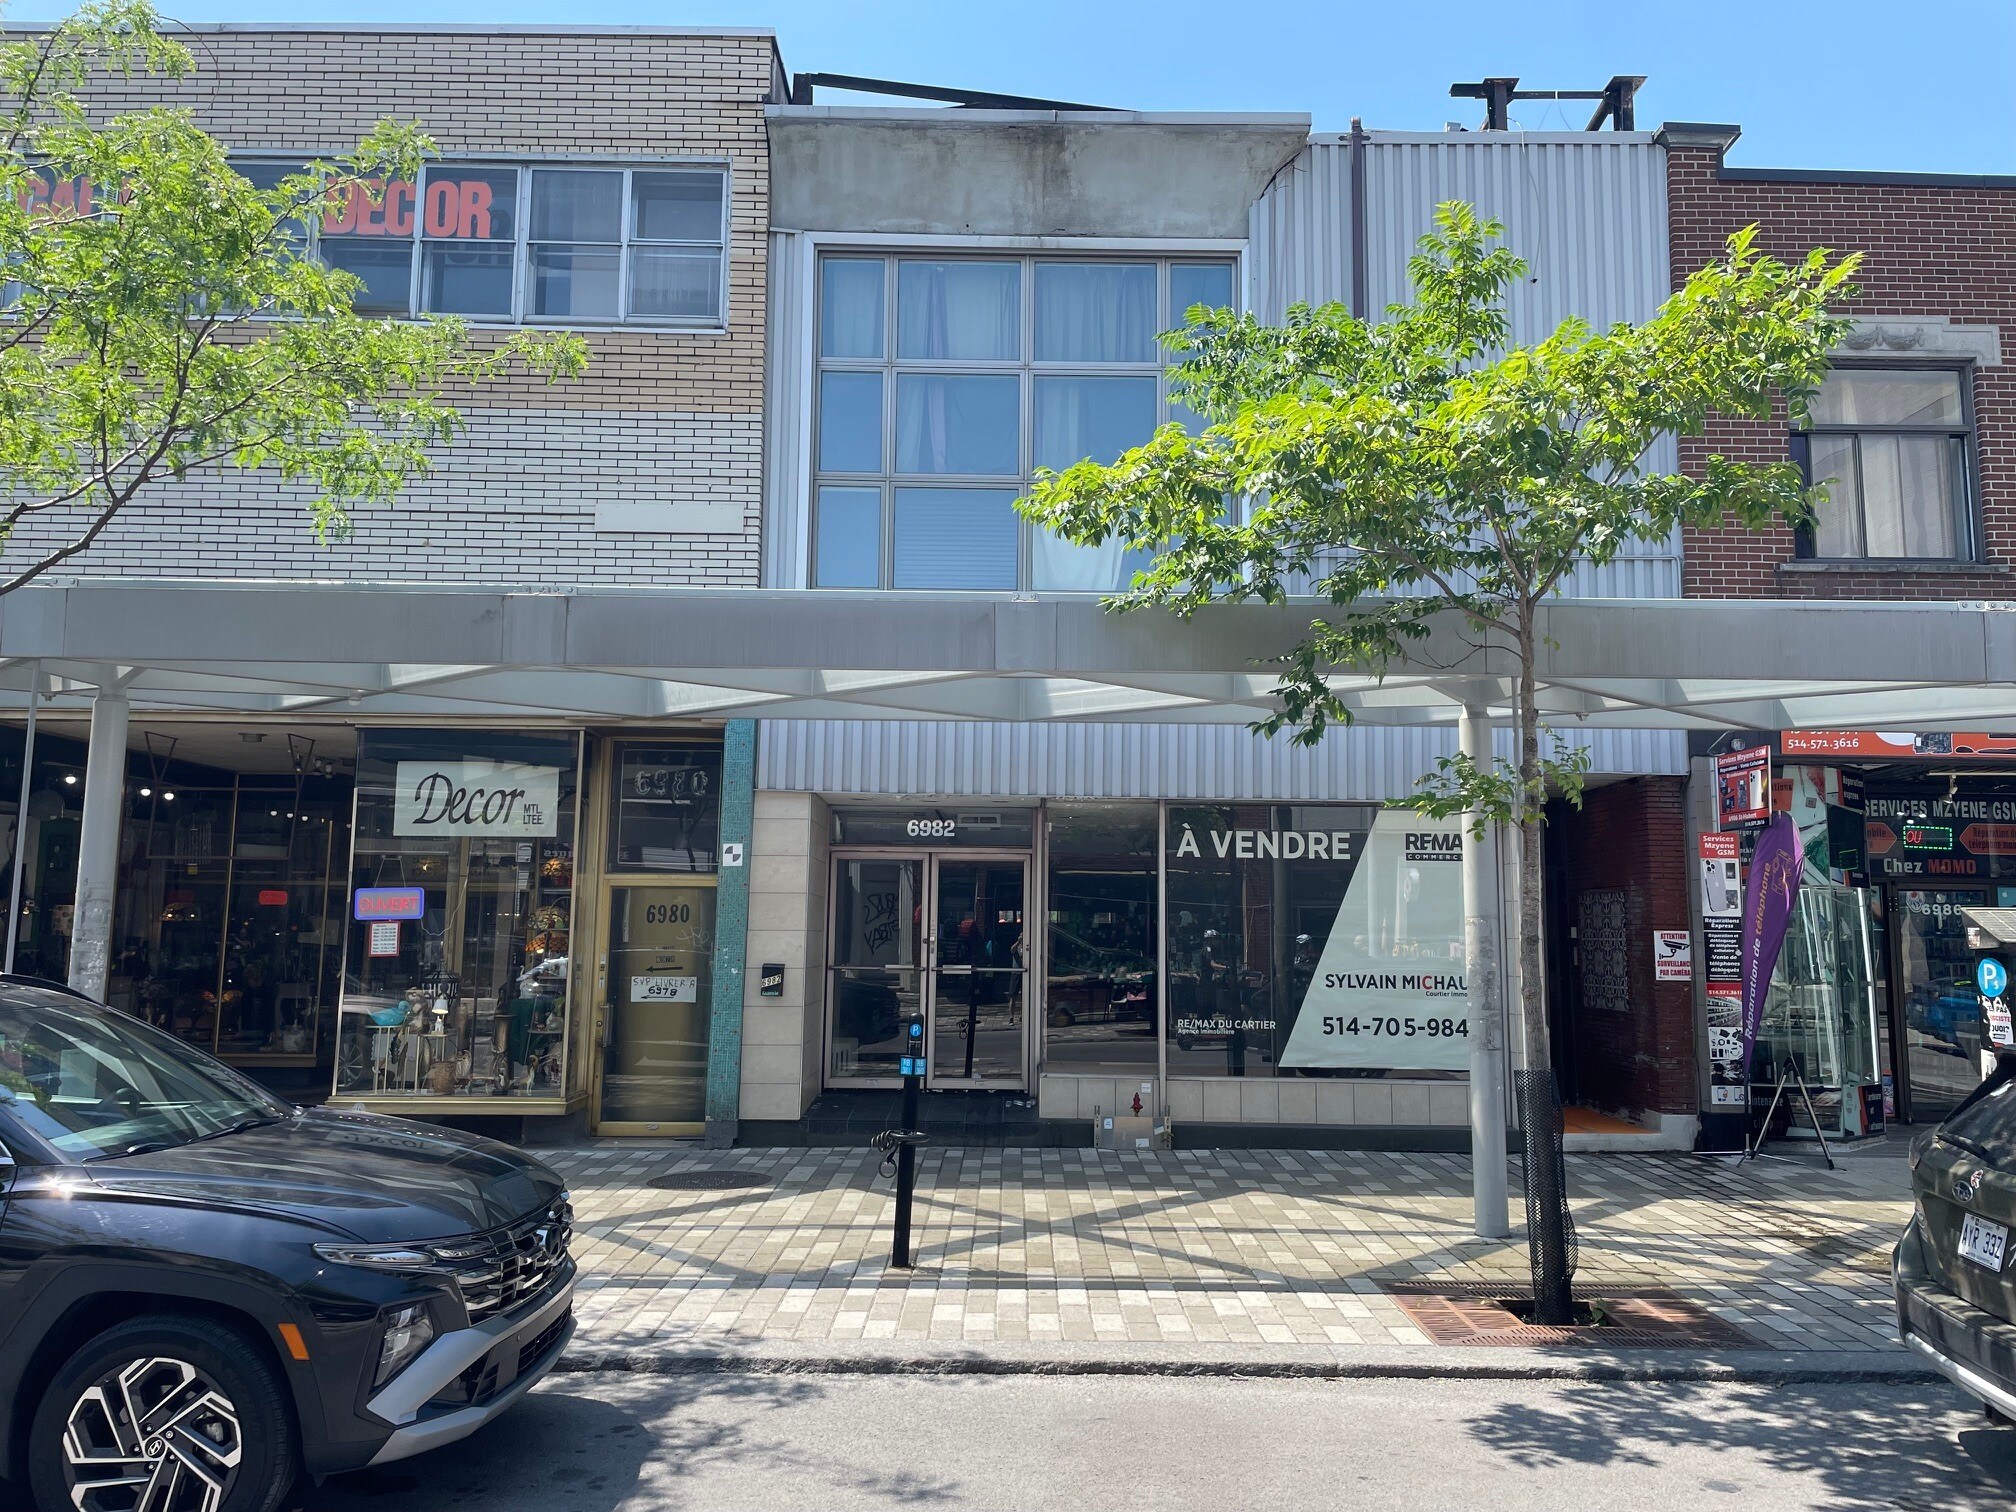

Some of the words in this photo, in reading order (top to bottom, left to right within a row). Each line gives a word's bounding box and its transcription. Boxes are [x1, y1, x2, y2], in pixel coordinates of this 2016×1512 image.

[324, 177, 494, 239] DECOR
[1788, 738, 1859, 749] 514.571.3616
[635, 770, 708, 796] 6980
[413, 772, 526, 824] Decor
[523, 804, 543, 814] MTL.
[1865, 800, 1927, 816] SERVICES
[1933, 801, 1987, 818] MZYENE
[907, 819, 955, 837] 6982
[1176, 823, 1201, 858] À
[1210, 830, 1351, 860] VENDRE
[1906, 831, 1922, 843] OU
[1704, 842, 1735, 850] Mzyene
[1883, 858, 1923, 873] Chez
[1928, 859, 1977, 874] MOMO
[360, 897, 419, 912] OUVERT
[1755, 862, 1771, 936] téléphone
[646, 904, 690, 923] 6980
[1921, 904, 1961, 916] 6986
[1755, 938, 1762, 957] de
[1657, 960, 1692, 968] SURVEILLANC
[1670, 968, 1691, 977] CAMÉRA
[633, 977, 651, 986] SVP
[655, 978, 686, 988] LIVRER
[1325, 973, 1397, 989] SYLVAIN
[1744, 958, 1762, 1039] Réparation
[1177, 1018, 1216, 1029] RE/MAX
[1218, 1019, 1232, 1029] DU
[1234, 1020, 1276, 1030] CARTIER
[1961, 1223, 1980, 1249] AYR
